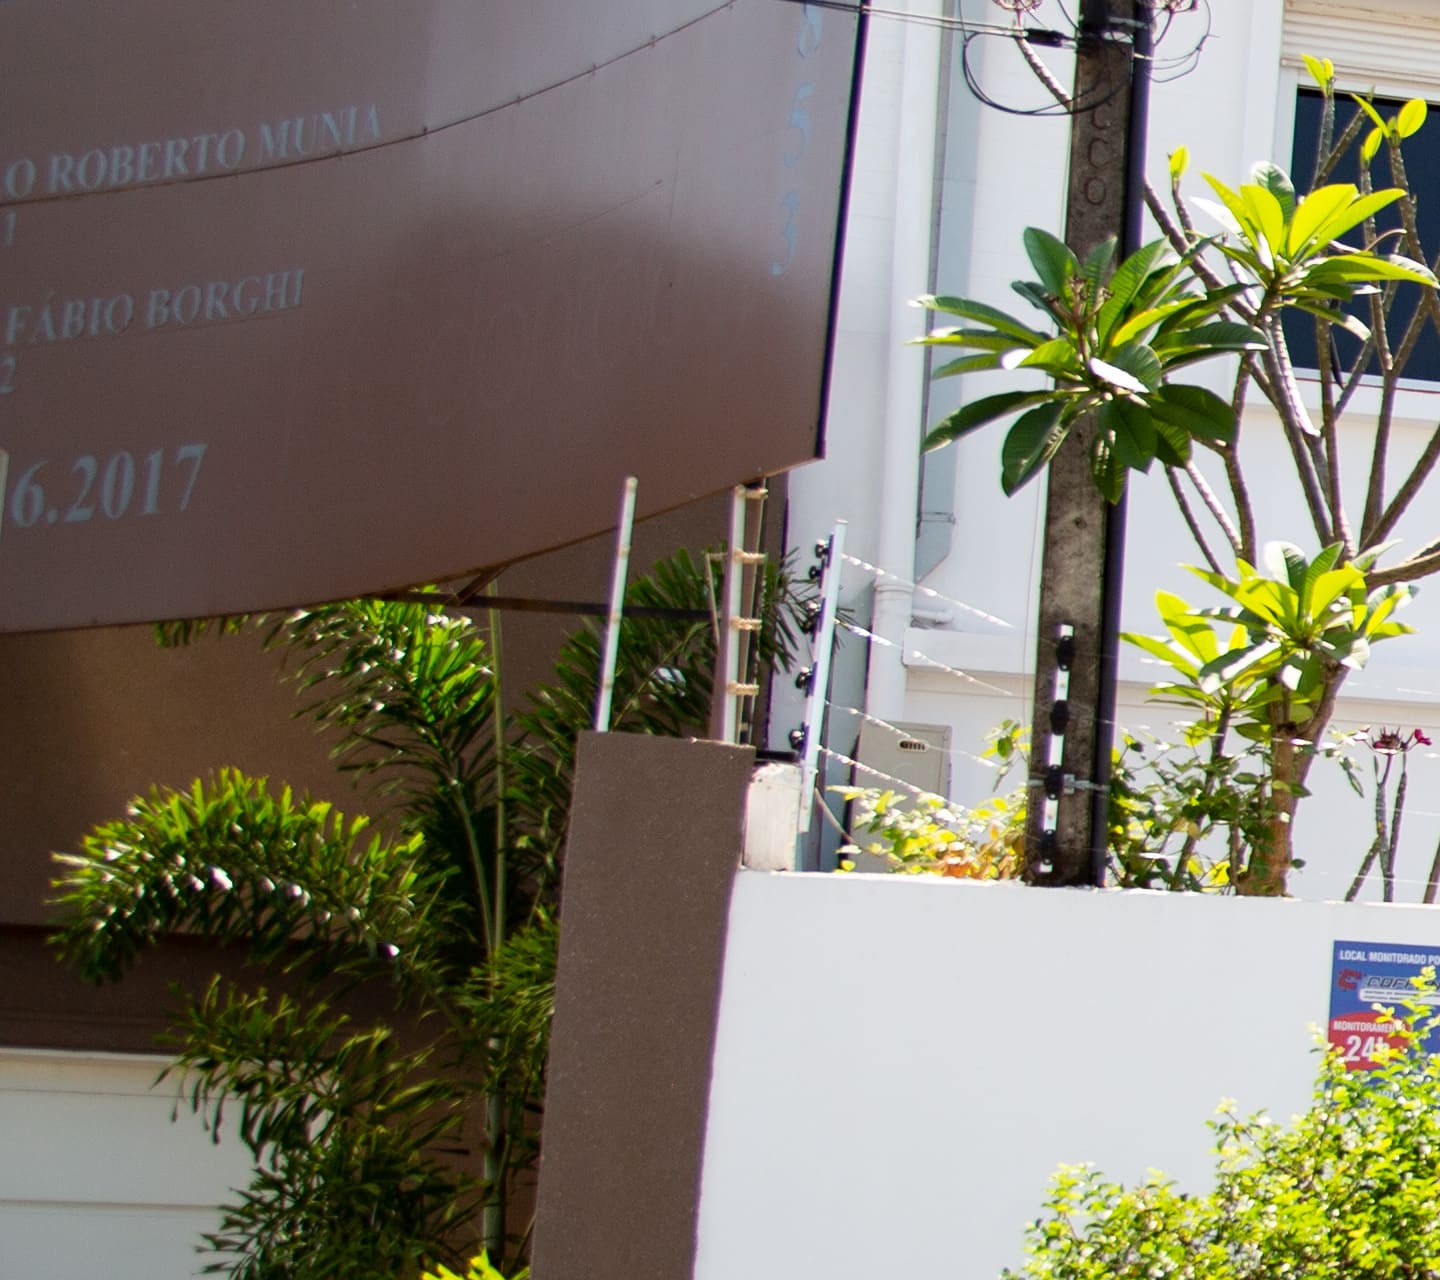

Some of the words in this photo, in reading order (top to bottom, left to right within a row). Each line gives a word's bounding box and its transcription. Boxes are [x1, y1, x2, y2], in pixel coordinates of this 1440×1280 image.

[47, 129, 247, 194] ROBERTO
[5, 287, 135, 345] FÁBIO
[145, 269, 305, 330] BORGHI
[1340, 950, 1367, 961] LOCAL
[1369, 951, 1427, 964] MONITORADO
